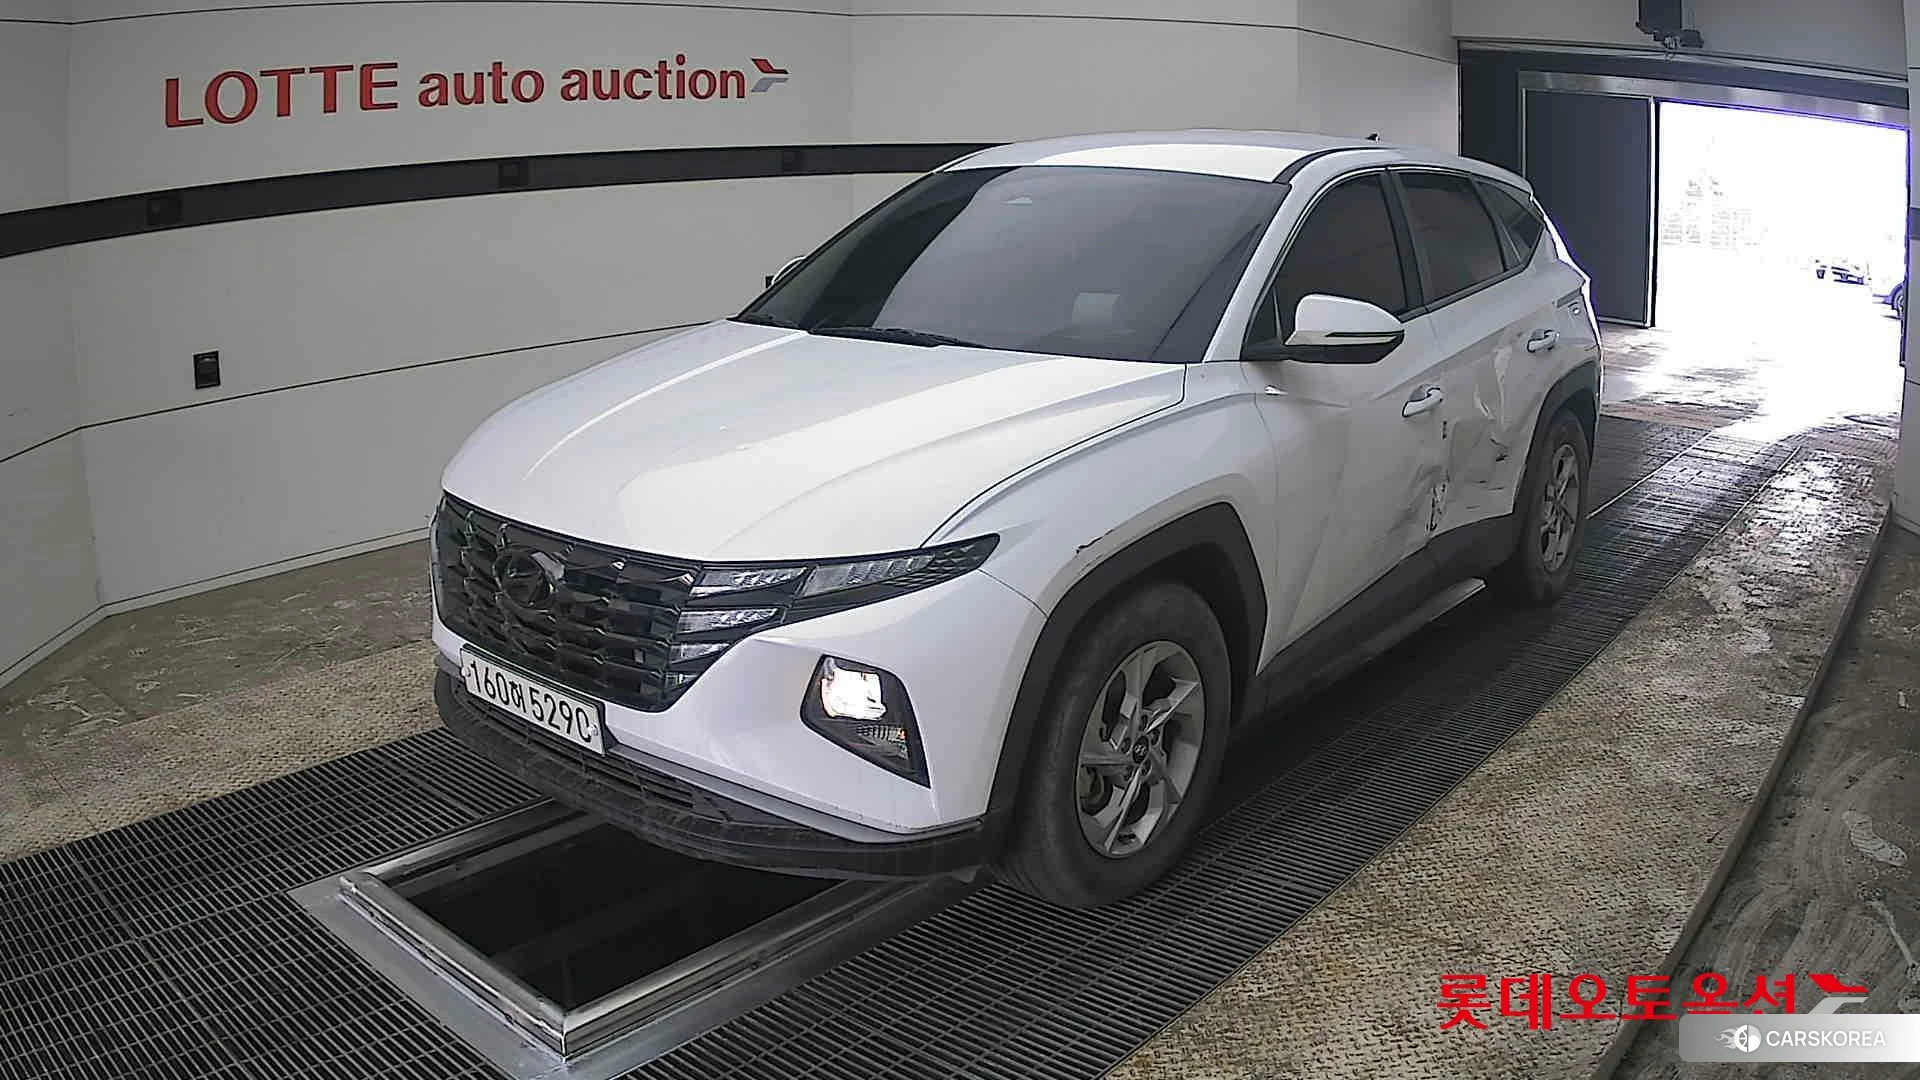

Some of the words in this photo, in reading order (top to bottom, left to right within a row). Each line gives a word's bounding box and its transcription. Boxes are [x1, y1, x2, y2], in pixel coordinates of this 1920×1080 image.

[165, 62, 398, 128] LOTTE
[418, 61, 545, 107] auto
[561, 54, 745, 100] auction
